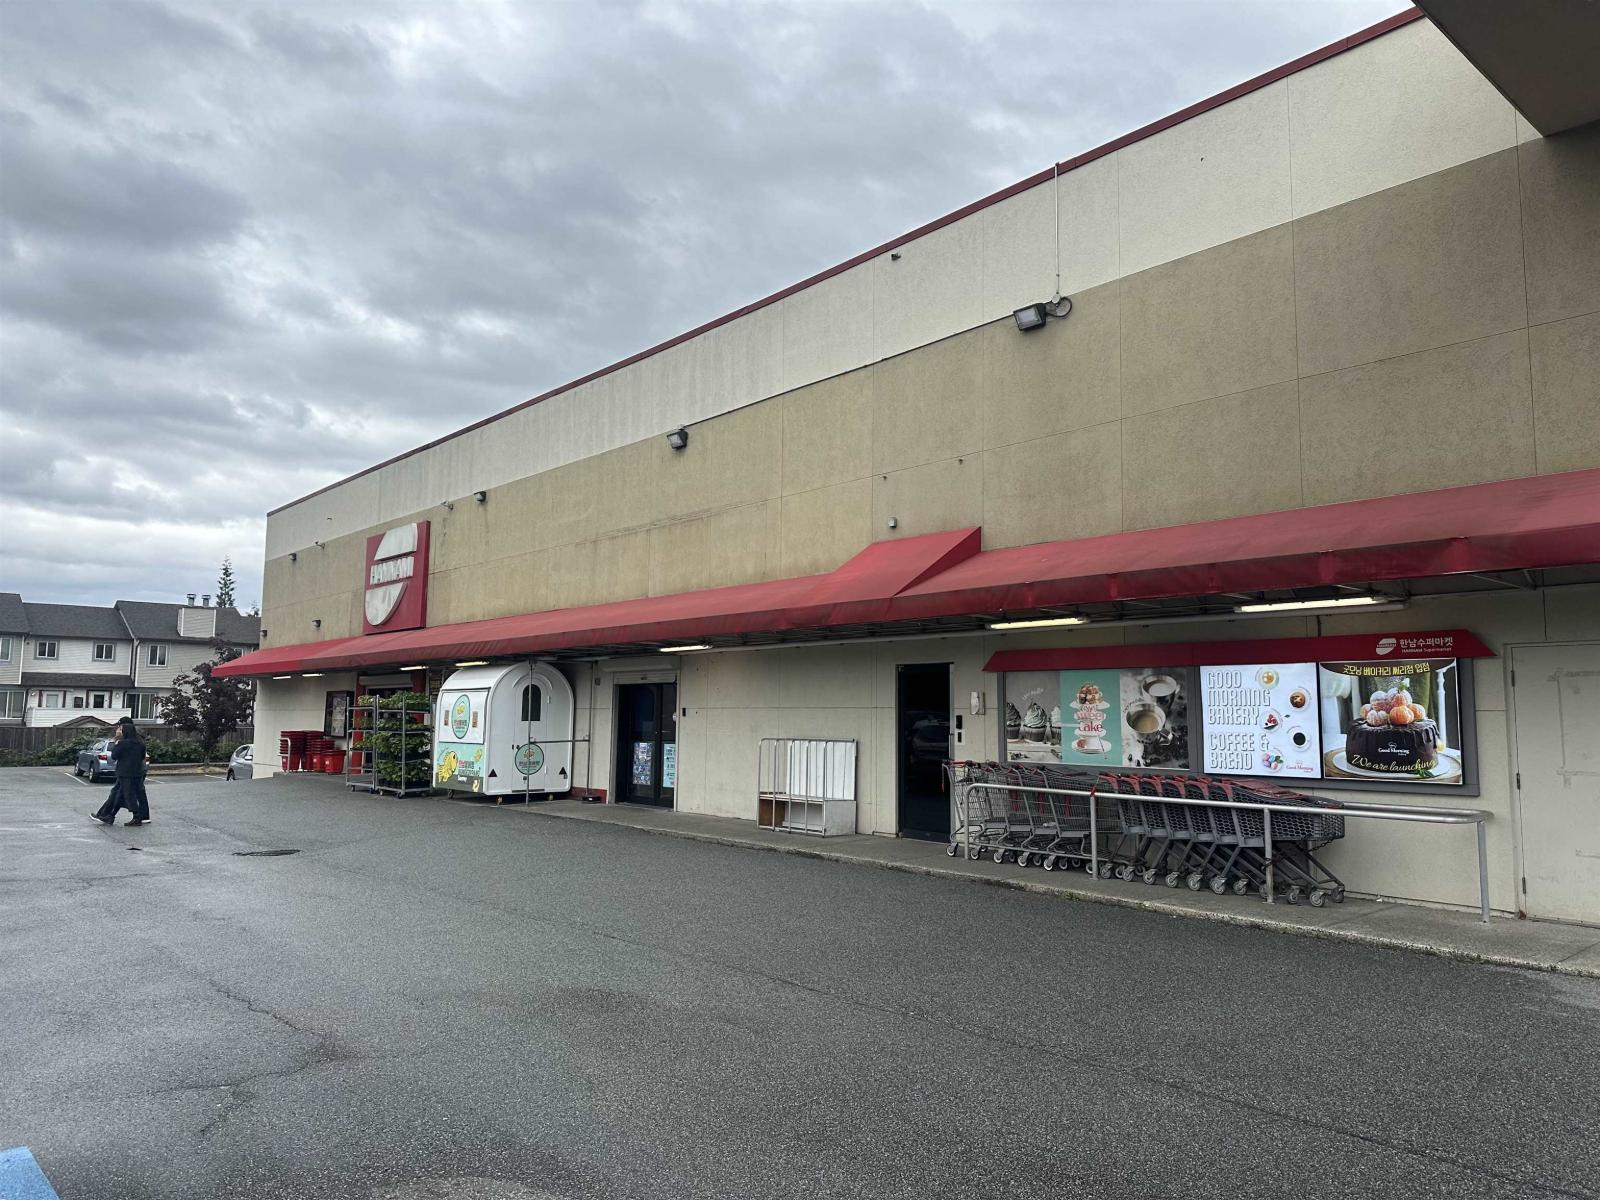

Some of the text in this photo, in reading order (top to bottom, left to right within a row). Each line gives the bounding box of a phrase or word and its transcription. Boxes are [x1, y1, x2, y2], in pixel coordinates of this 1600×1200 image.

[370, 556, 414, 585] HANNAM
[1400, 637, 1453, 648] 한남수퍼마켓
[1208, 670, 1242, 688] GOOD
[1343, 664, 1362, 676] 굿모닝
[1363, 665, 1391, 676] 베이커리
[1208, 688, 1271, 707] MORNING
[1208, 707, 1260, 725] BAKERY
[1210, 733, 1270, 752] COFFEE &
[1210, 751, 1253, 771] BREAD
[1351, 754, 1437, 772] We are launching
